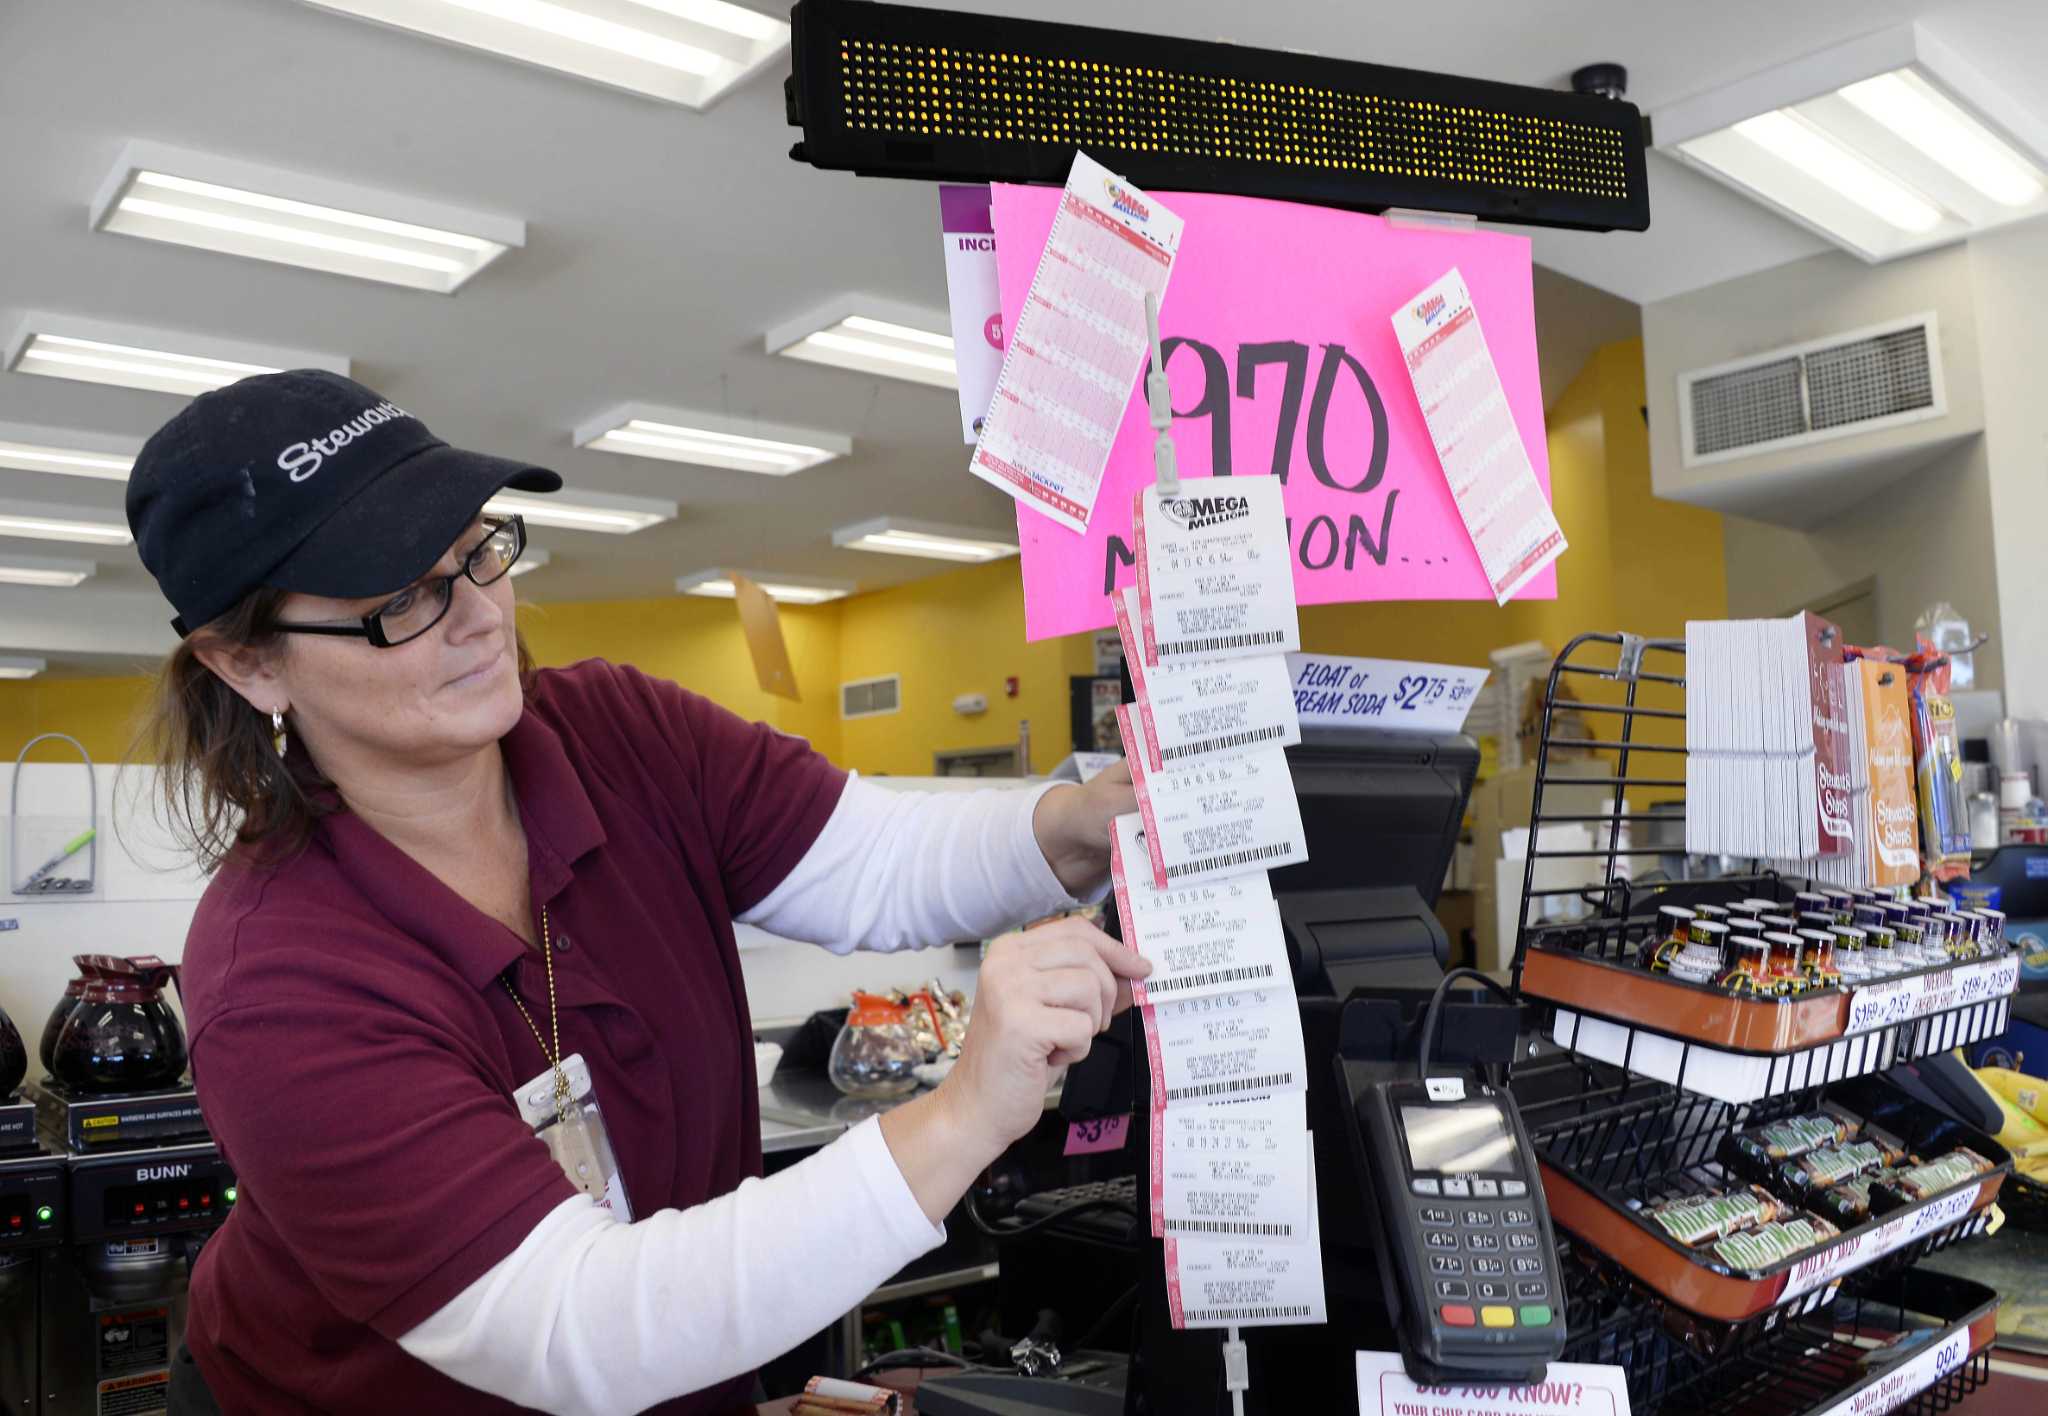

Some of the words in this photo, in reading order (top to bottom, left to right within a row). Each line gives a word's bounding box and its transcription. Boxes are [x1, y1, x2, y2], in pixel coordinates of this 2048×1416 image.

[1143, 336, 1390, 494] 970
[1190, 496, 1249, 519] MEGA
[1297, 662, 1353, 687] FLOAT
[1349, 674, 1370, 689] or
[1293, 690, 1344, 715] REAM
[1342, 693, 1389, 716] SODA
[1884, 819, 1912, 850] Shops
[136, 1163, 188, 1182] BUNN
[1427, 1208, 1435, 1221] 1
[1467, 1211, 1477, 1223] 2
[1508, 1211, 1518, 1222] 3
[1431, 1233, 1441, 1245] 4
[1472, 1234, 1482, 1247] 5
[1512, 1234, 1521, 1247] 6
[1436, 1257, 1446, 1269] 7
[1478, 1258, 1488, 1271] 8
[1517, 1259, 1527, 1272] 9
